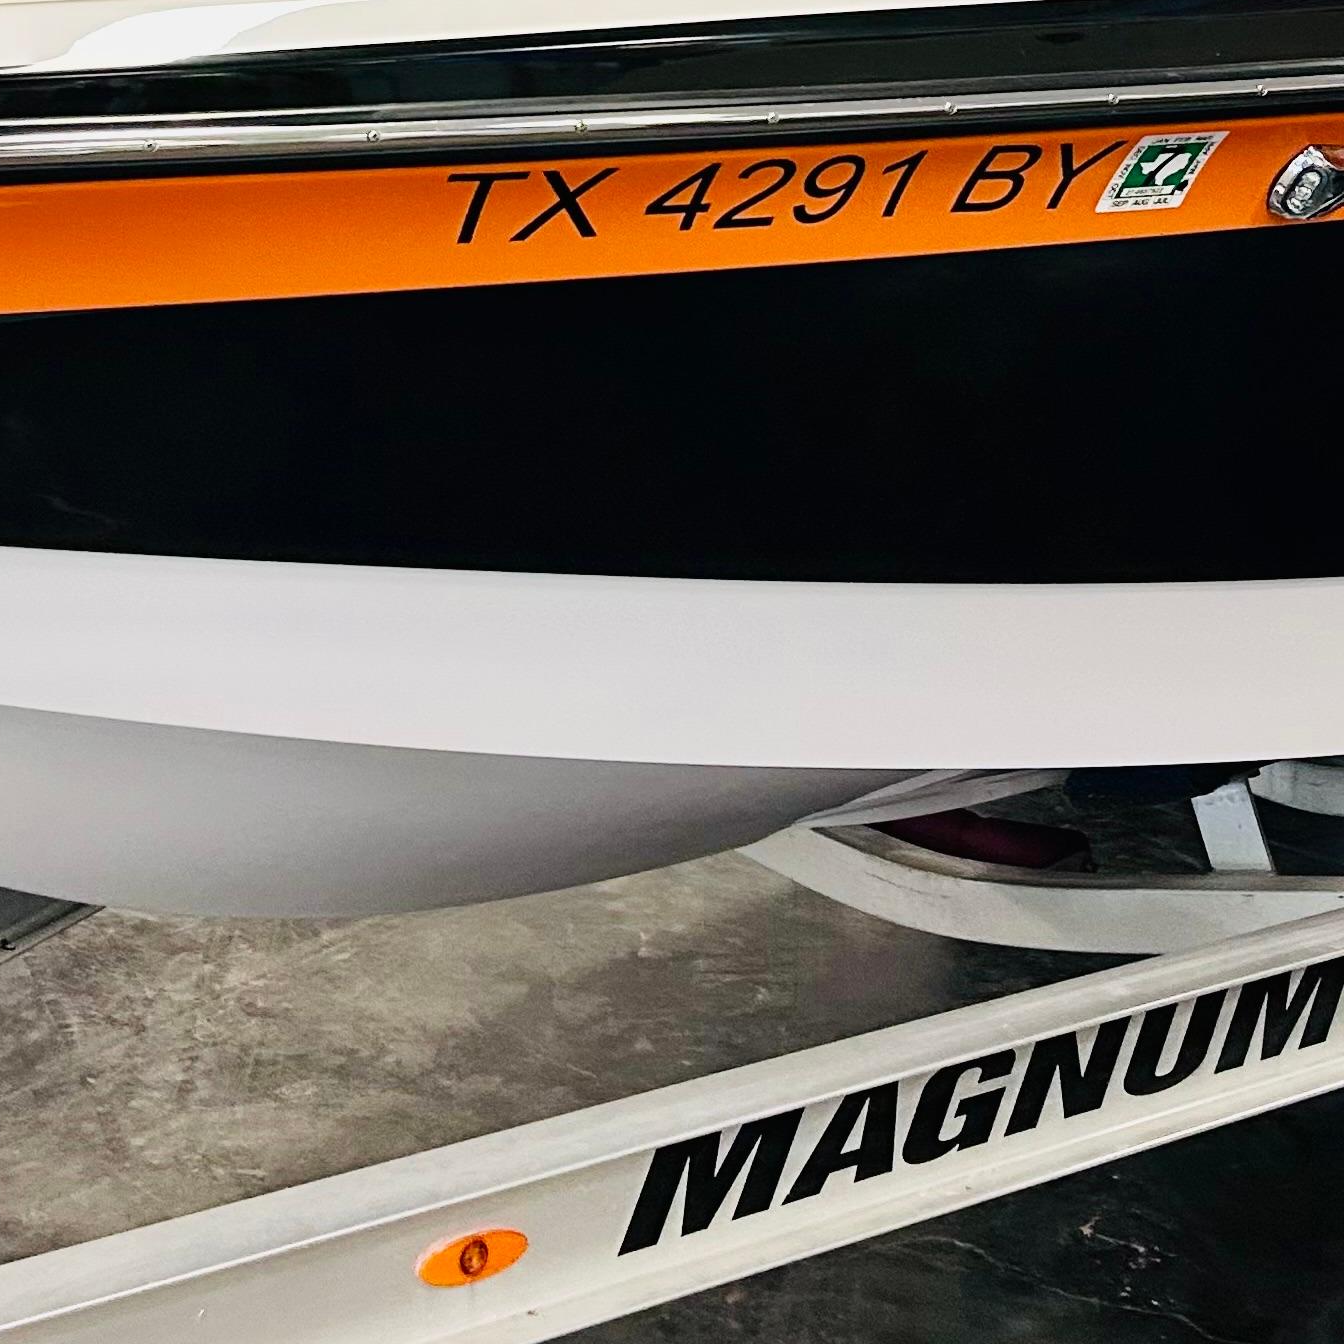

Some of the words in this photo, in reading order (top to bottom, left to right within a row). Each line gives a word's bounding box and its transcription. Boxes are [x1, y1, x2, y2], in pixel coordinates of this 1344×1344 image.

[446, 167, 621, 244] TX
[644, 150, 927, 231] 4291
[951, 140, 1128, 213] BY
